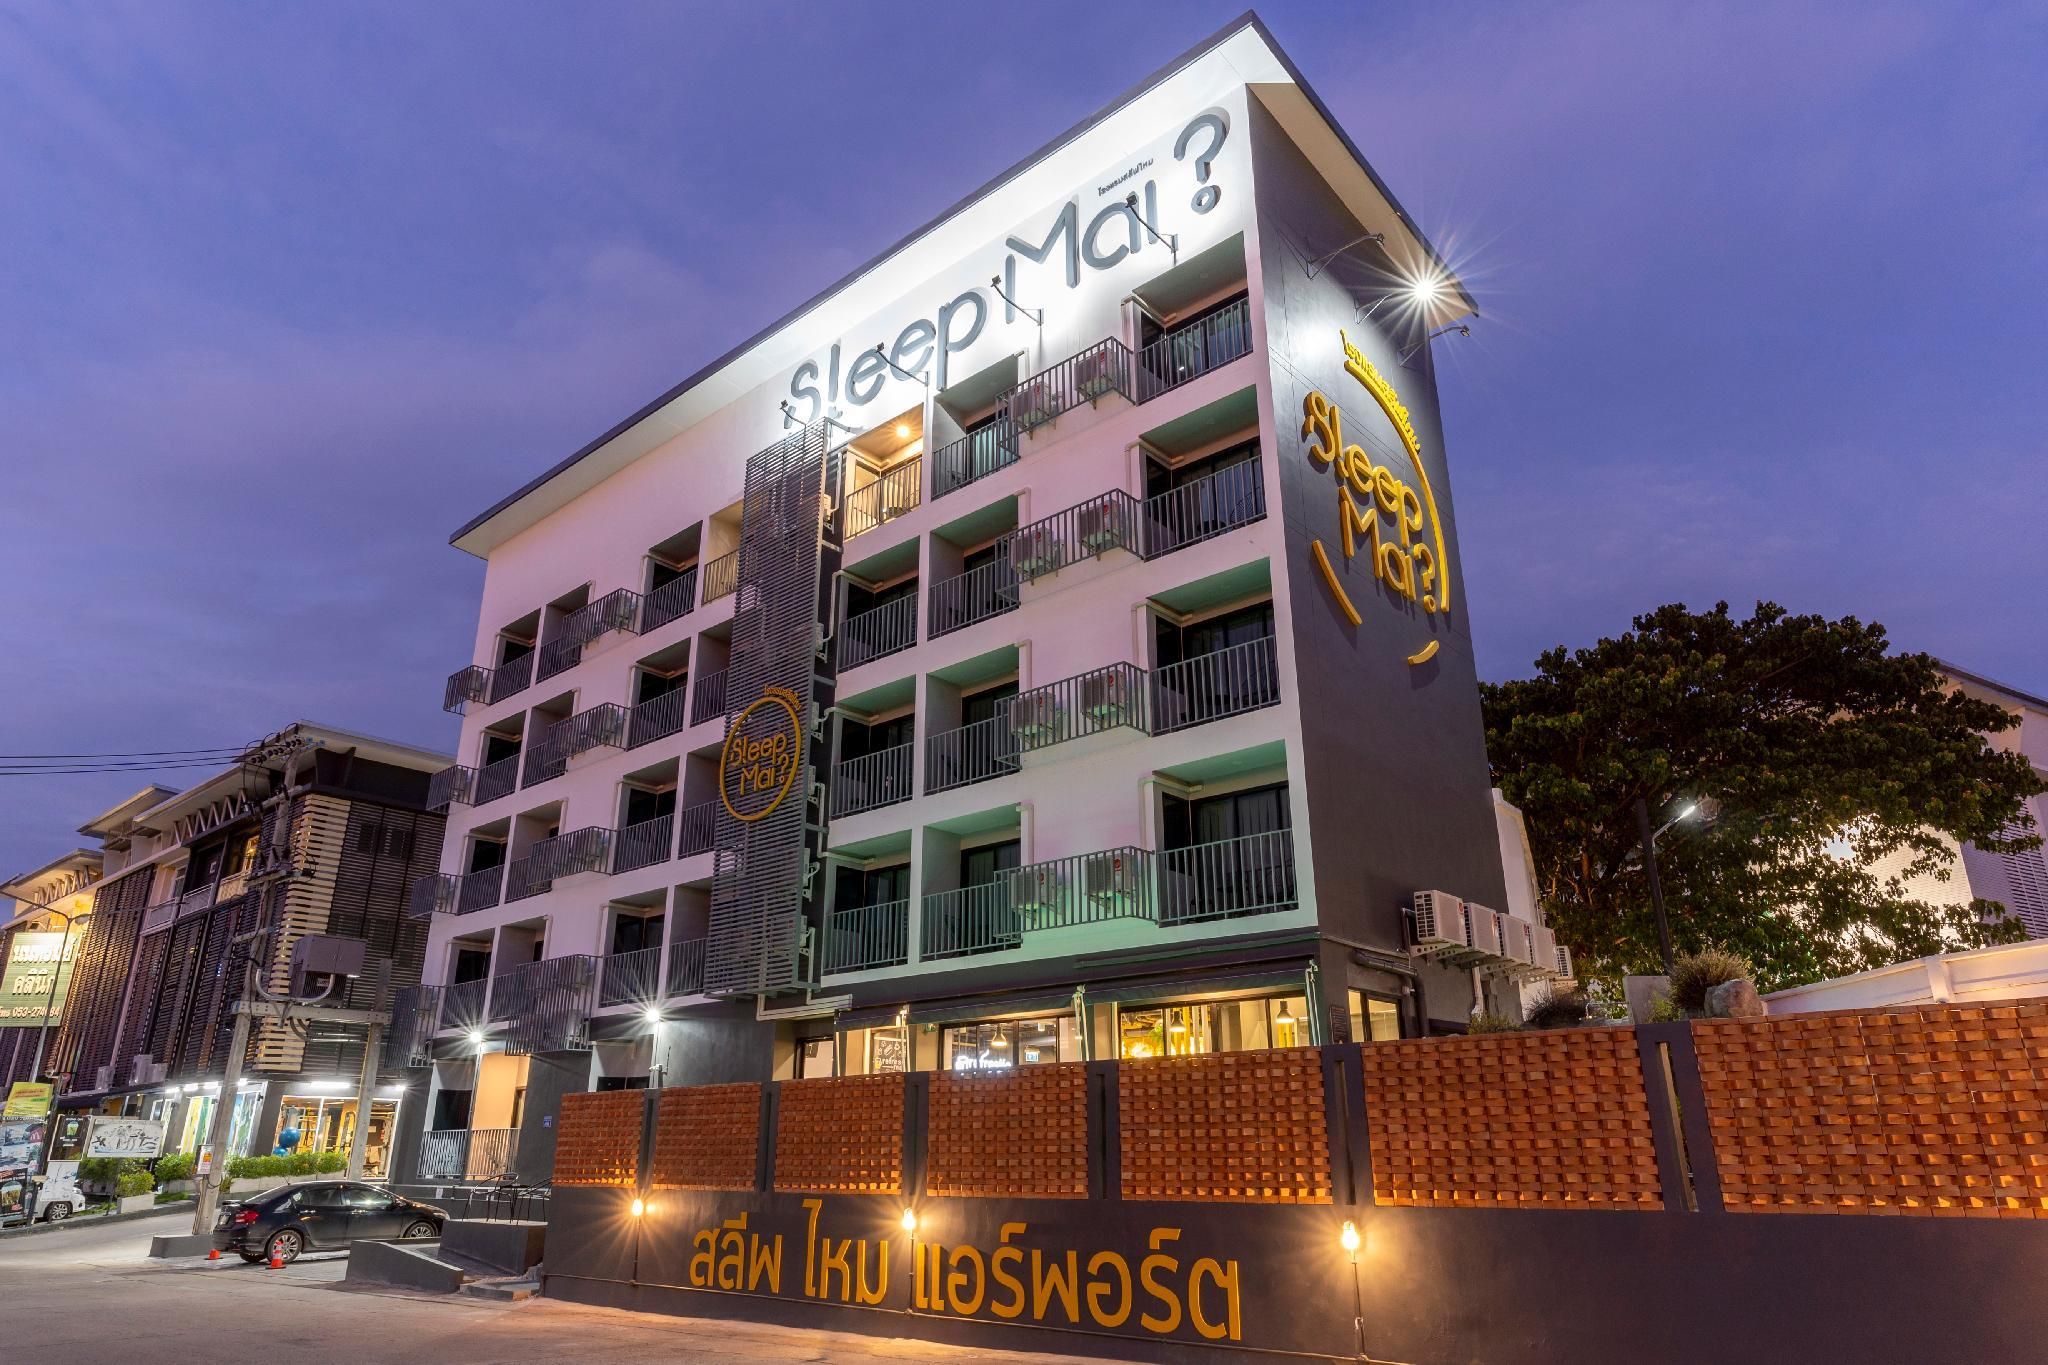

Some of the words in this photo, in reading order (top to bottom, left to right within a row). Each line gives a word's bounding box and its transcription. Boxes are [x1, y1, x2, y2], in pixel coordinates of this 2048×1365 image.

[783, 286, 988, 430] Sleep
[1303, 391, 1424, 548] Sleep
[730, 732, 788, 768] Sleep
[689, 1211, 783, 1294] สลีพ
[802, 1199, 889, 1306] ไหม
[915, 1222, 1241, 1342] แอร์พอร์ต
